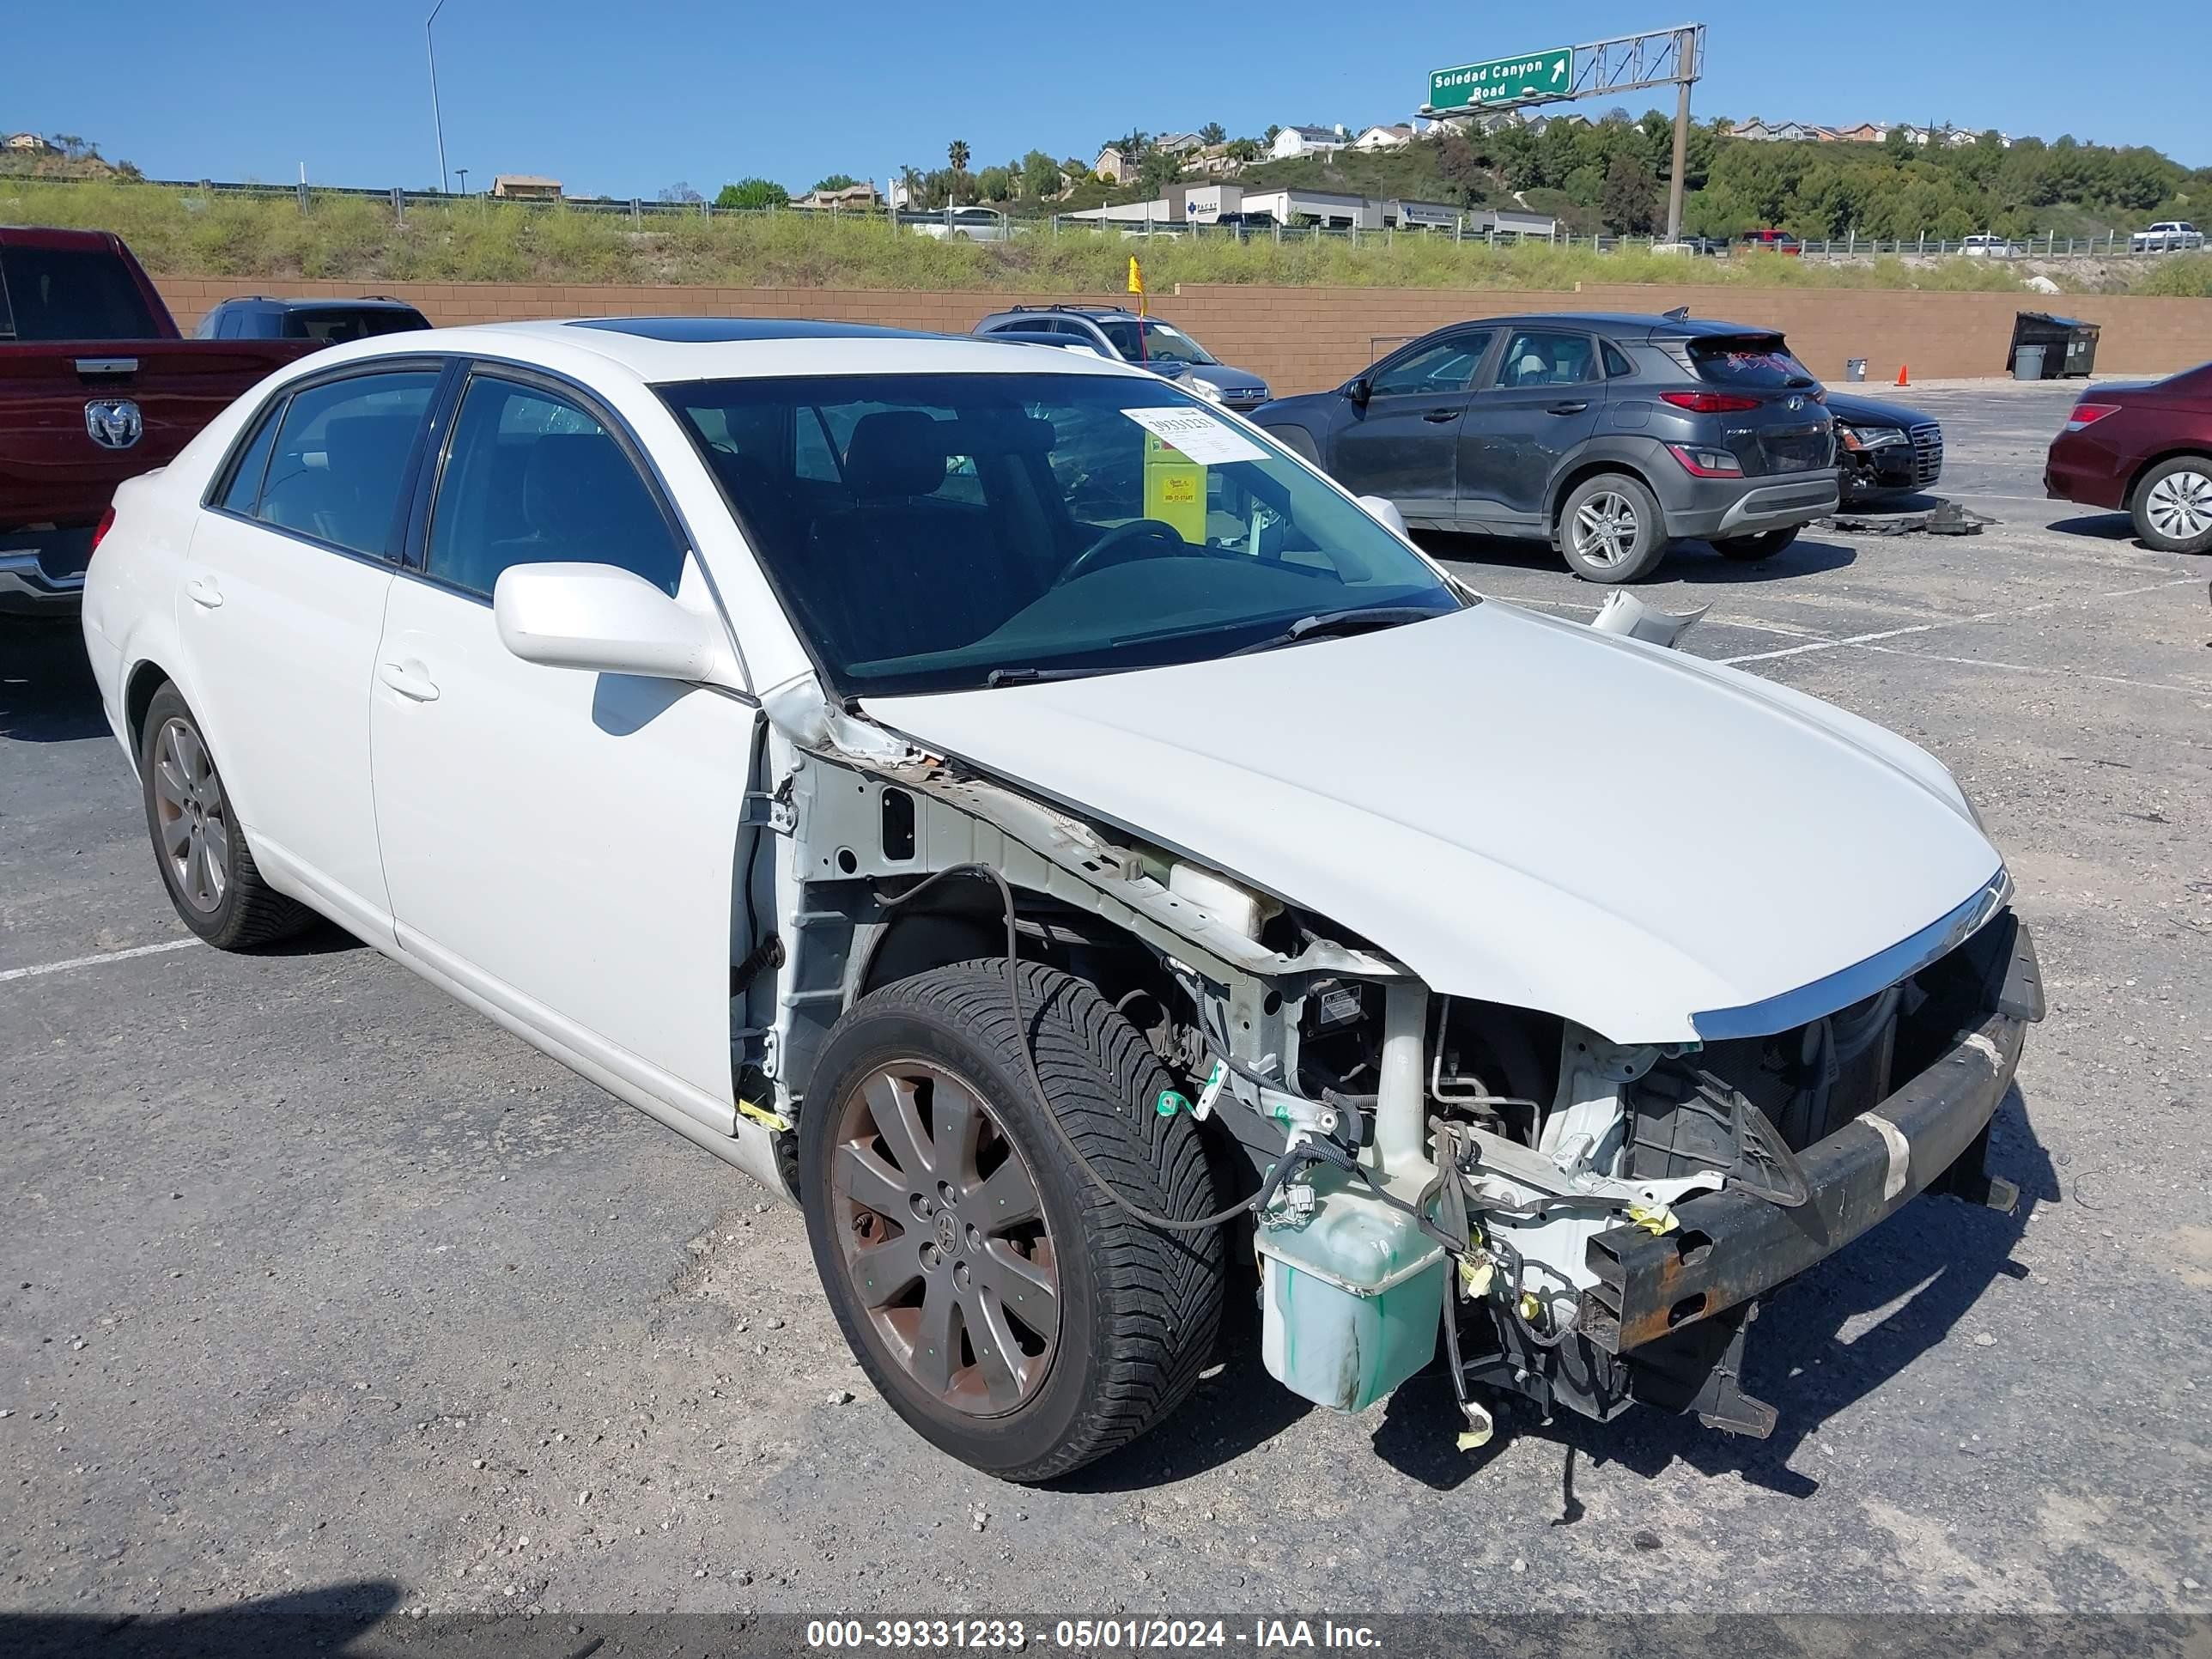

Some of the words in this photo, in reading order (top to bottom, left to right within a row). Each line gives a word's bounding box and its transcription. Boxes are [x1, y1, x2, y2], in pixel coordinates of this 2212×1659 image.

[1435, 68, 1487, 88] Soledad
[1492, 59, 1542, 80] Canyon
[1474, 83, 1505, 100] Road
[1148, 418, 1216, 431] 39331233
